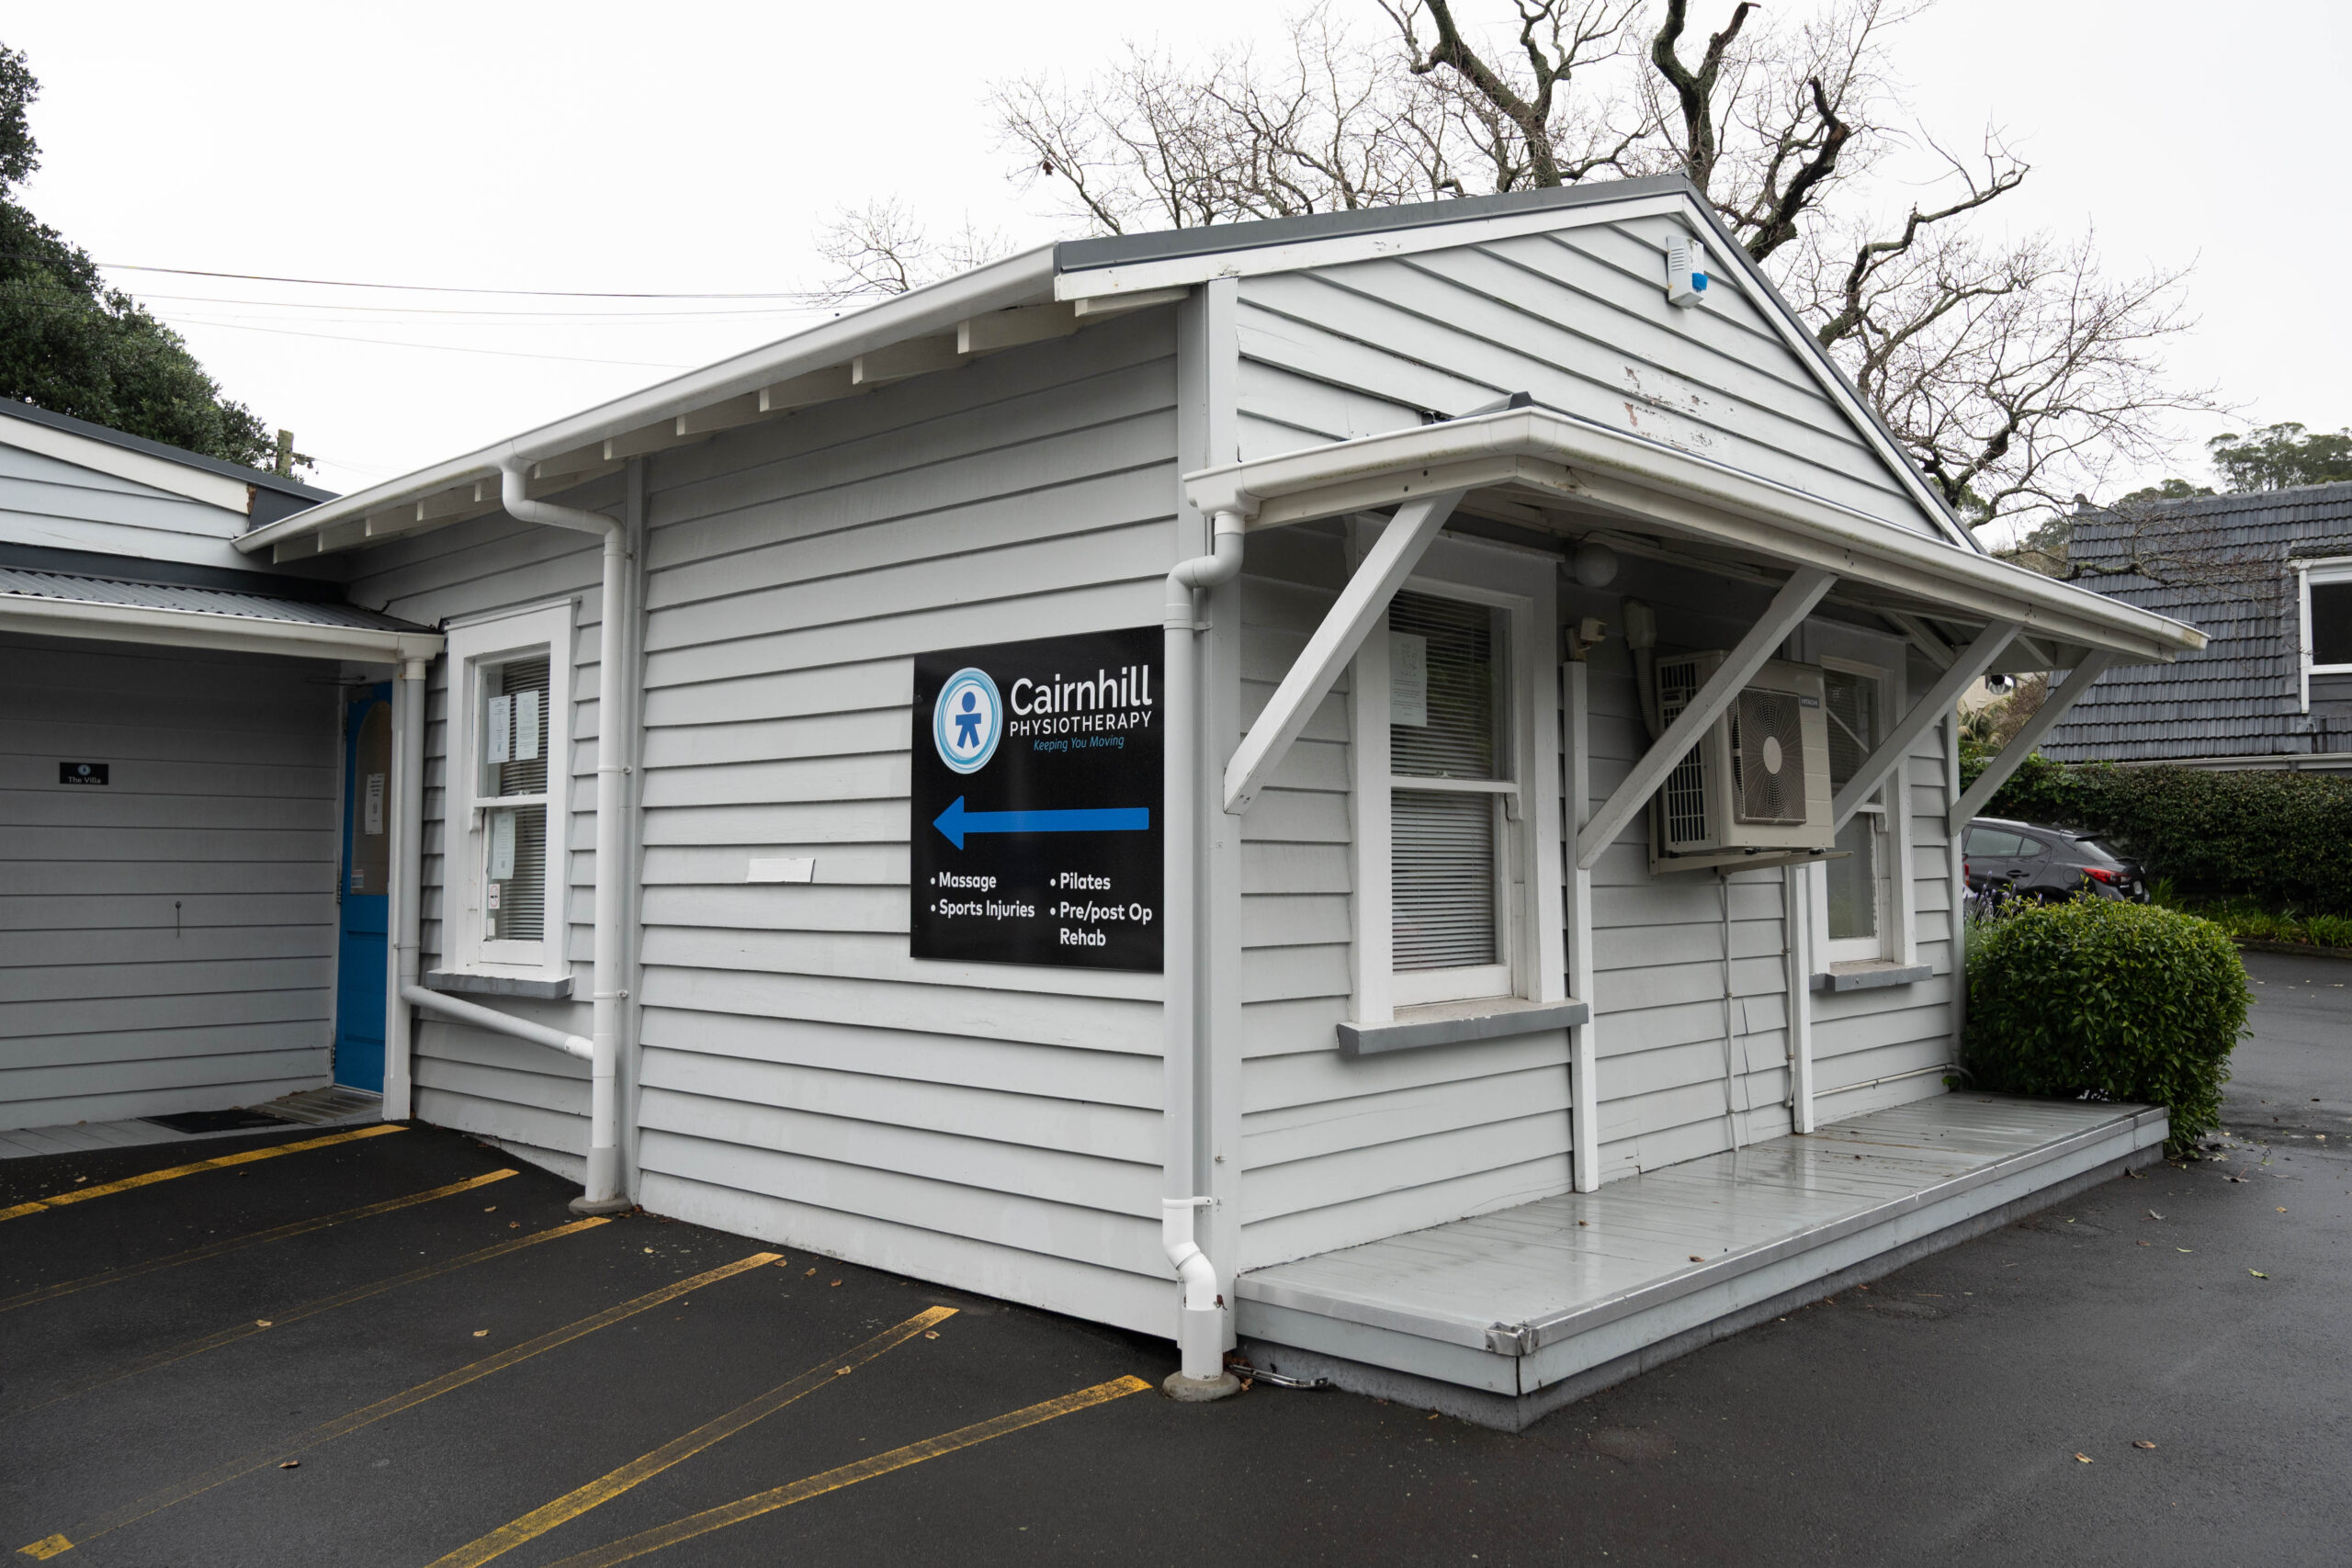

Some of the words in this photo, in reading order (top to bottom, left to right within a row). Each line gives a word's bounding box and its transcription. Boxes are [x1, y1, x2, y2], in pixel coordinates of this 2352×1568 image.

[1011, 664, 1153, 716] Cairnhill
[1010, 711, 1153, 737] PHYSIOTHERAPY
[1034, 739, 1068, 752] Keeping
[1071, 737, 1087, 749] You
[1090, 735, 1125, 750] Moving
[939, 872, 997, 892] Massage
[1060, 873, 1111, 890] Pilates
[939, 899, 983, 919] Sports
[987, 900, 1035, 920] Injuries
[1059, 900, 1125, 923] Pre/post
[1129, 903, 1153, 925] Op
[1060, 929, 1106, 947] Rehab
